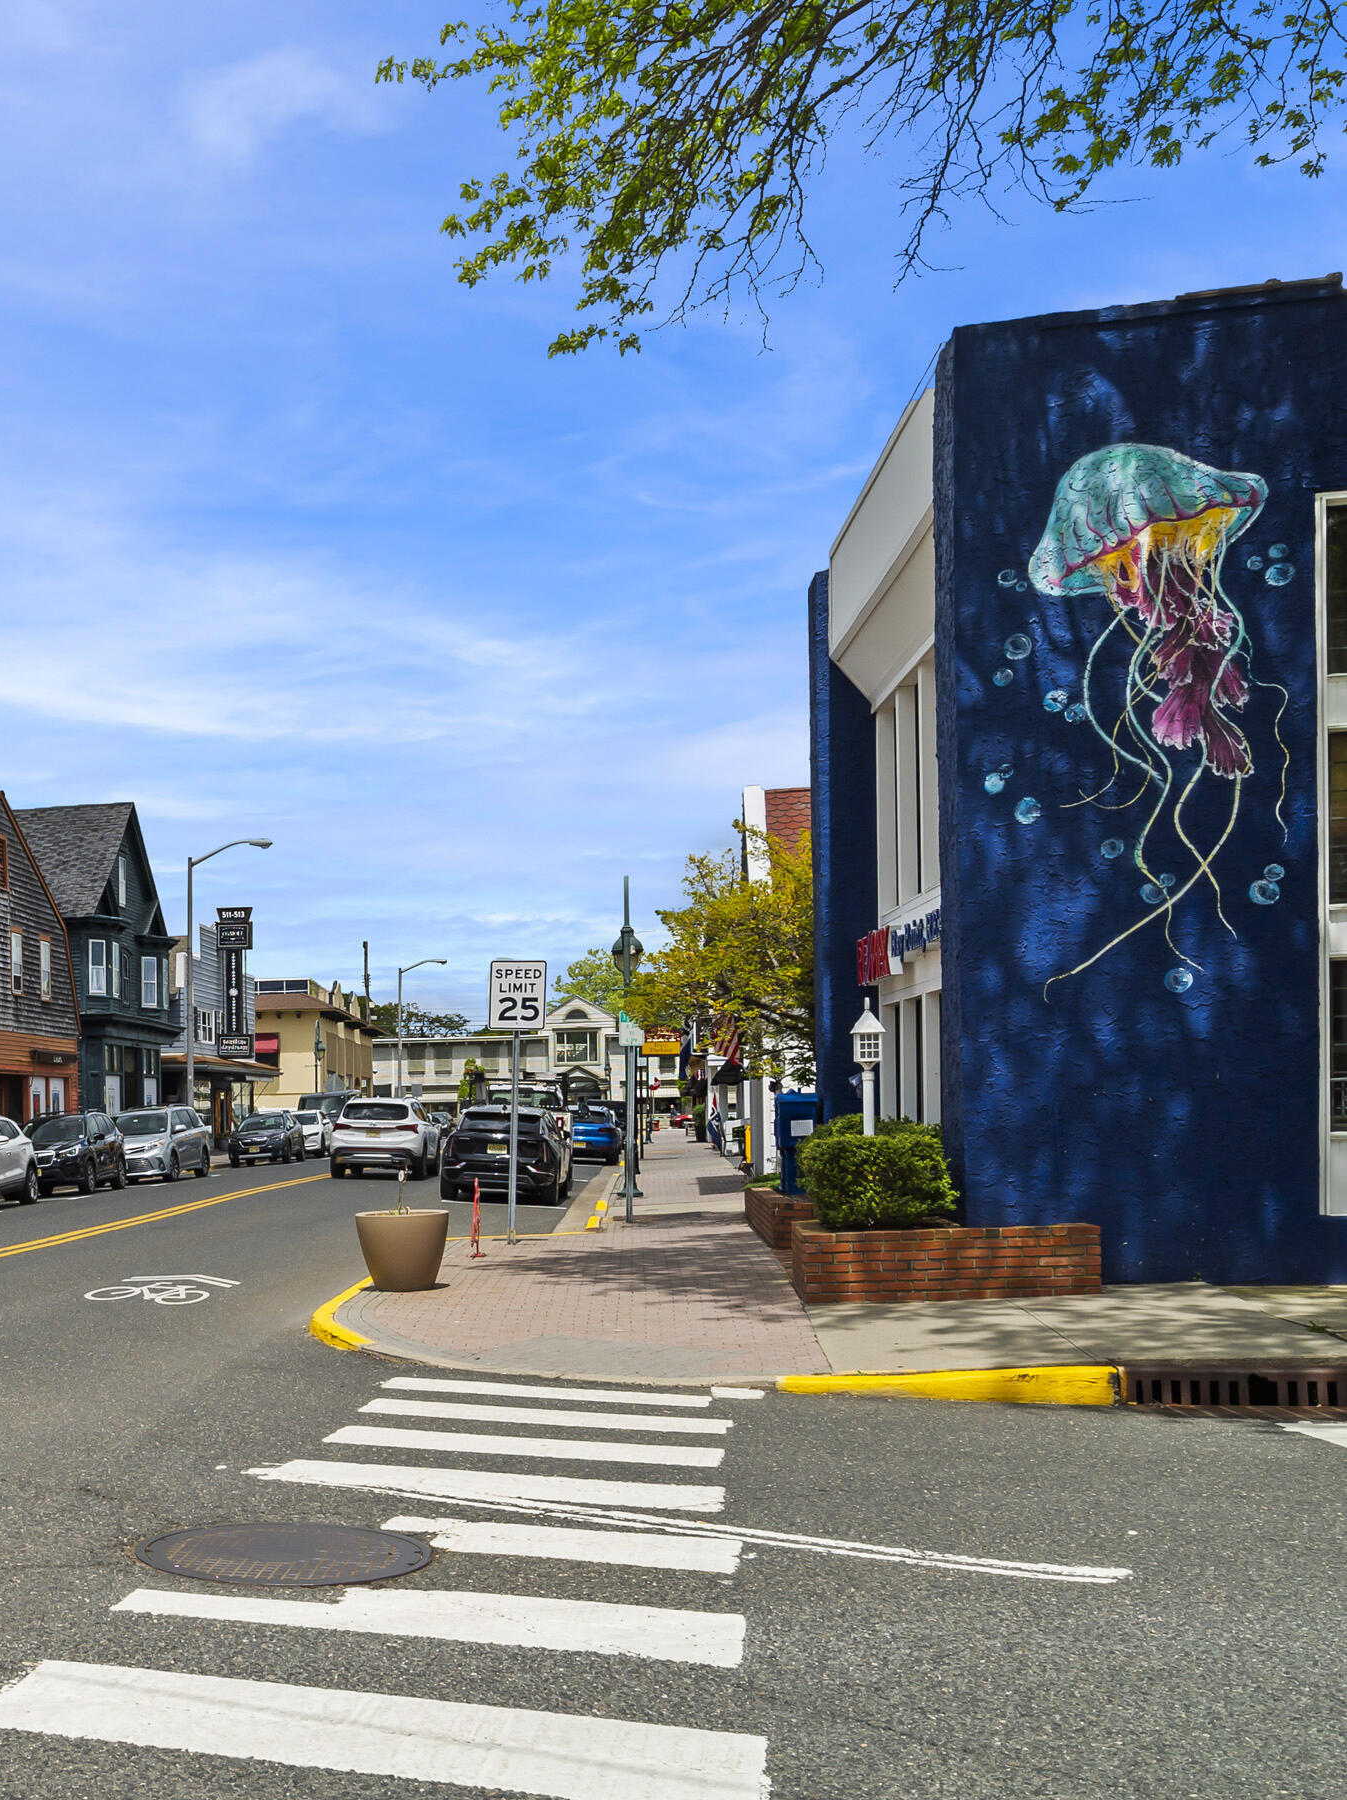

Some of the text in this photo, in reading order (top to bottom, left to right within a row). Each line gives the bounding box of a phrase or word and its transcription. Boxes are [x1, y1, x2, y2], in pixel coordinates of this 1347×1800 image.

[857, 925, 891, 986] RE/MAX
[495, 968, 542, 979] SPEED
[499, 983, 537, 993] LIMIT
[498, 996, 540, 1022] 25
